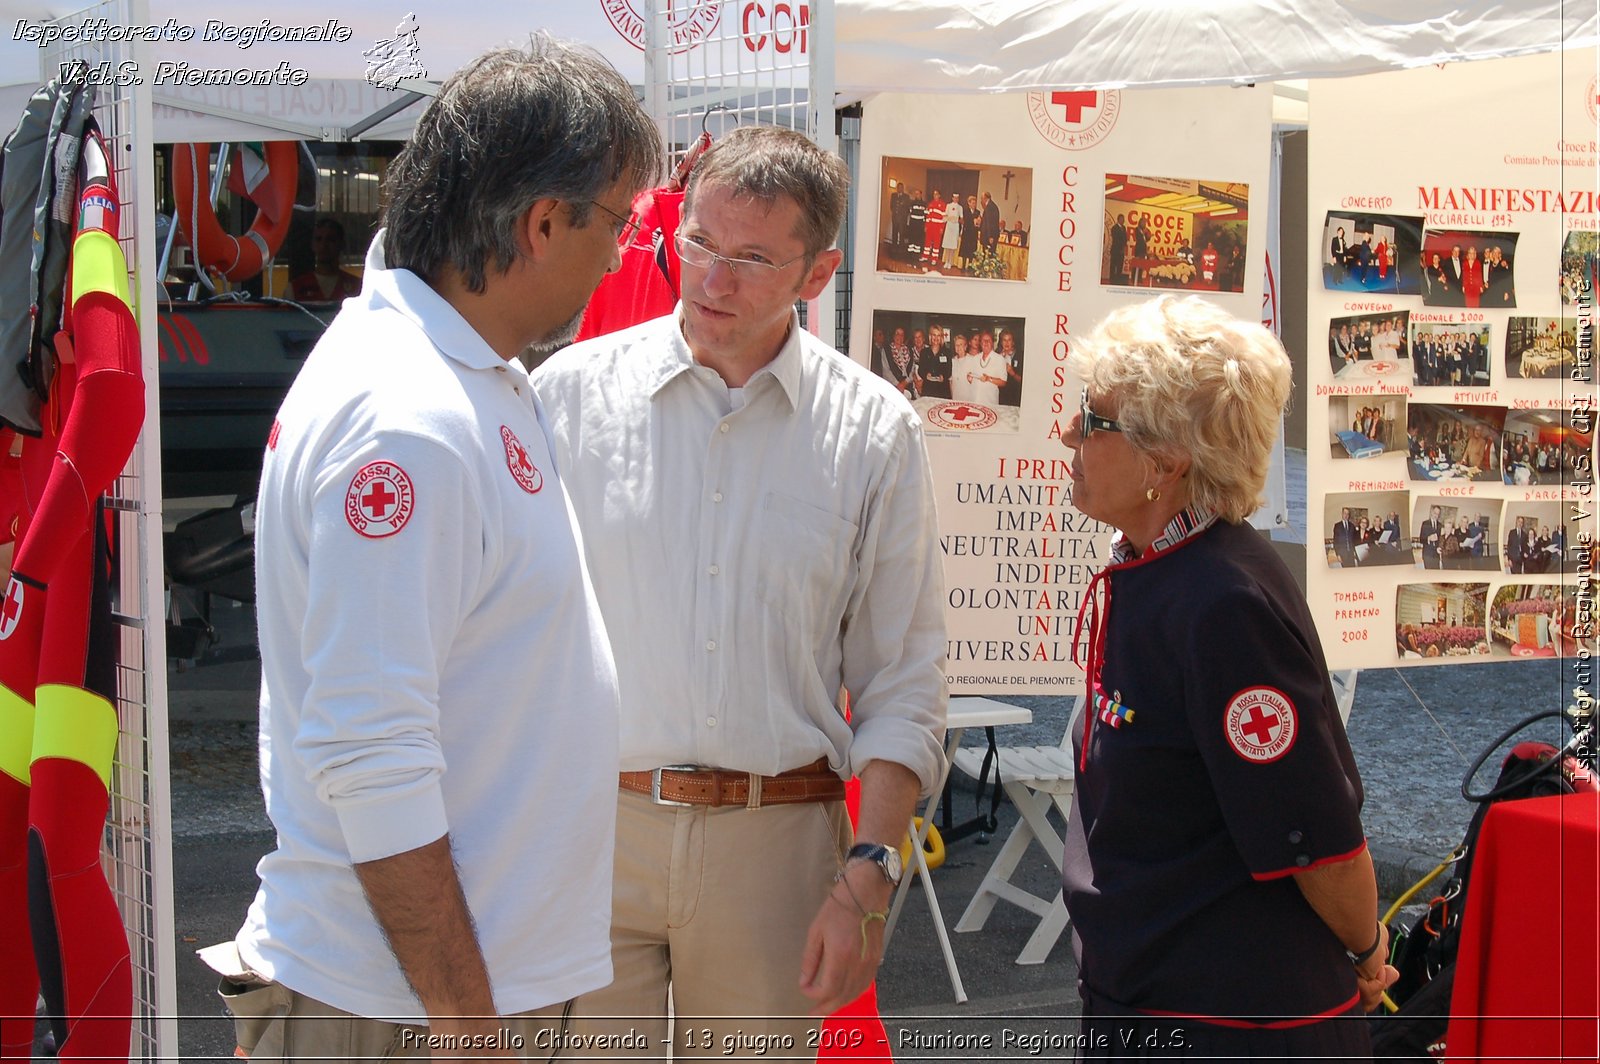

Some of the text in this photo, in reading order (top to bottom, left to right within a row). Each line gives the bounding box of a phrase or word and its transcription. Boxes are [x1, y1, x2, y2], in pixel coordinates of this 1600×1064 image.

[1503, 155, 1541, 166] Comitato
[1127, 210, 1184, 231] CROCE
[1341, 197, 1392, 209] CONCERTO
[1423, 213, 1485, 226] RICCIARELLI
[1057, 166, 1078, 292] CROCE
[1567, 217, 1600, 229] SFILA
[1344, 302, 1484, 323] CONVEGNO REGIONALE 2000
[1513, 399, 1539, 410] SOCIO
[998, 458, 1006, 478] I
[354, 465, 410, 529] ROSSA ITALIANA
[1349, 481, 1404, 491] PREMIAZIONE
[1439, 486, 1475, 497] CROCE
[349, 493, 368, 530] CROCE
[995, 563, 1107, 585] INDIPEN
[1334, 591, 1374, 602] TOMBOLA
[1335, 609, 1380, 620] PREMENO
[1342, 630, 1368, 643] 2008
[957, 676, 1008, 685] REGIONALE
[1010, 676, 1027, 685] DEL
[1030, 676, 1075, 686] PIEMONTE
[1230, 694, 1288, 733] CROCE ROSSA ITALIANA
[1235, 720, 1291, 756] COMITATO FEMMINILE
